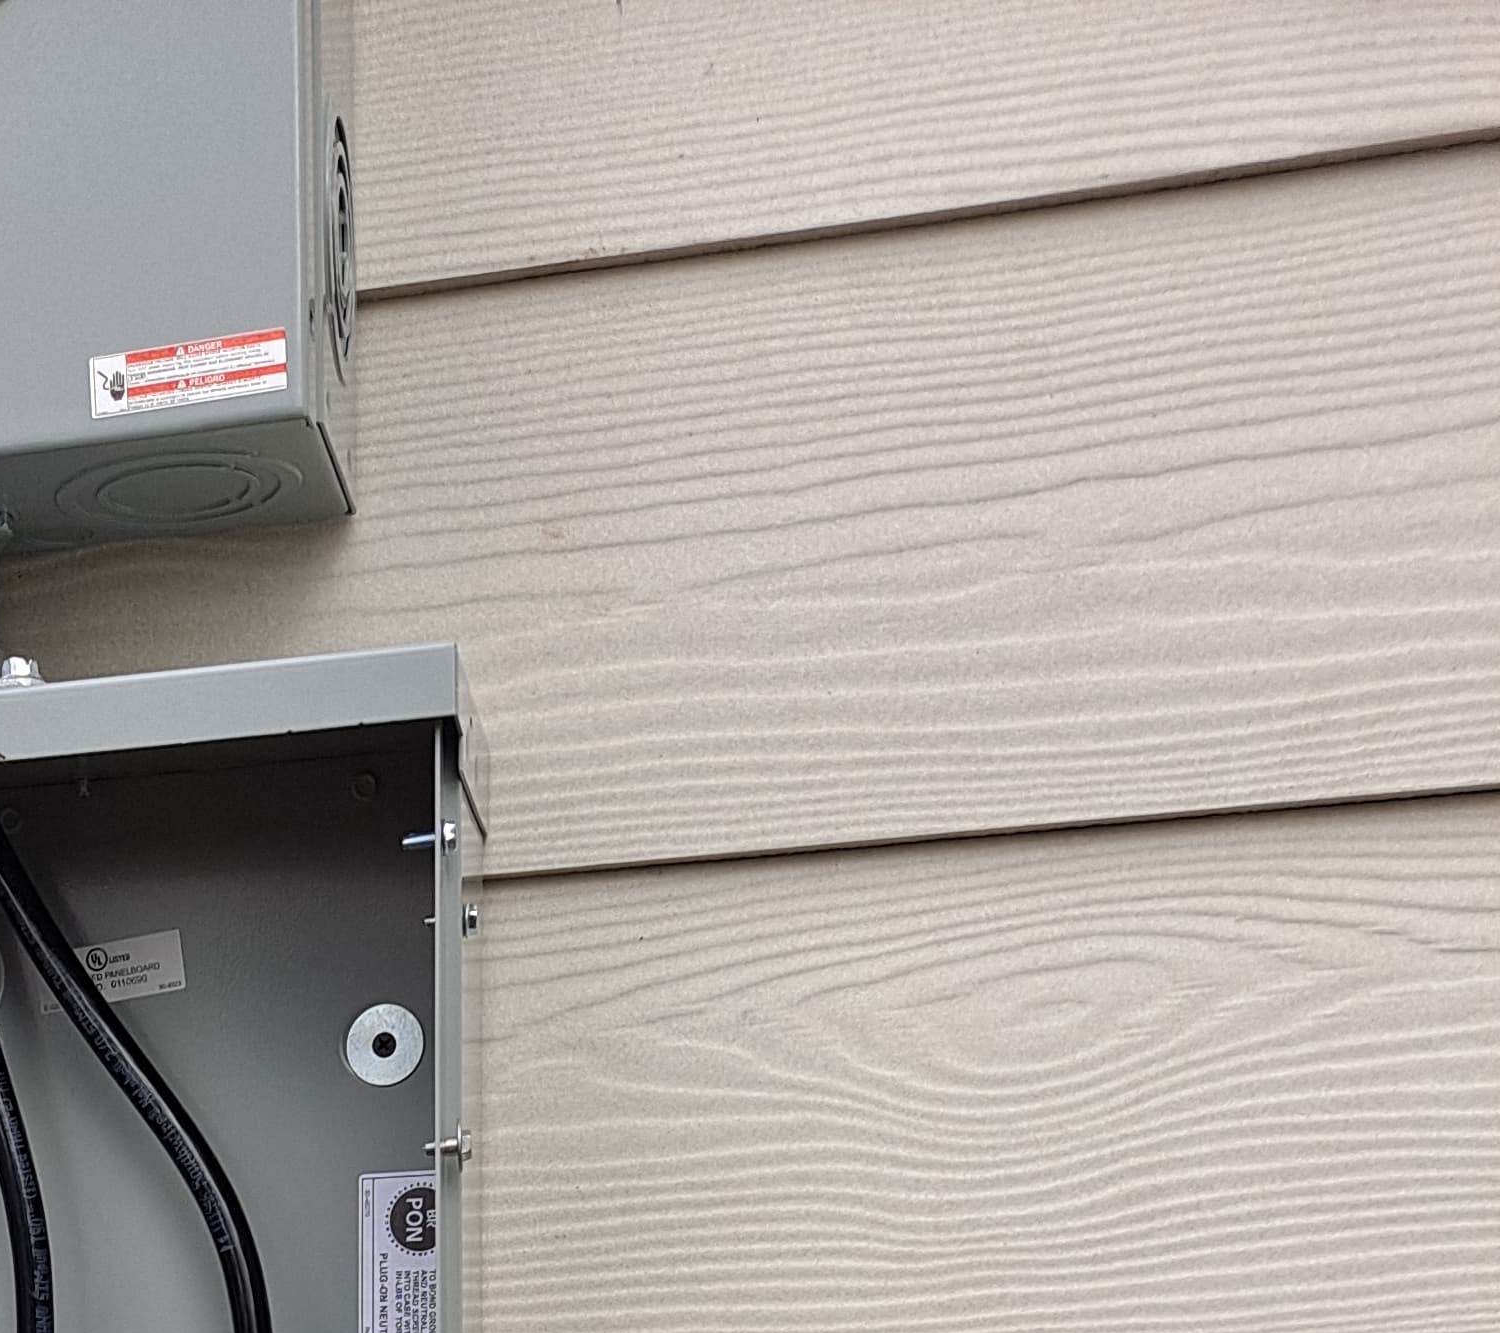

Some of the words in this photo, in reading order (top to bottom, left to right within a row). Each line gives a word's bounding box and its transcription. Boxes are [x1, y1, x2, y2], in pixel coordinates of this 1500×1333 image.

[187, 340, 223, 354] DANGER
[104, 962, 161, 980] PANELBOARD
[405, 1197, 424, 1243] PON
[379, 1252, 389, 1302] PLUG-ON
[421, 1270, 429, 1288] AND
[412, 1270, 420, 1307] THREAD
[395, 1302, 402, 1315] OF
[403, 1293, 411, 1315] CASE
